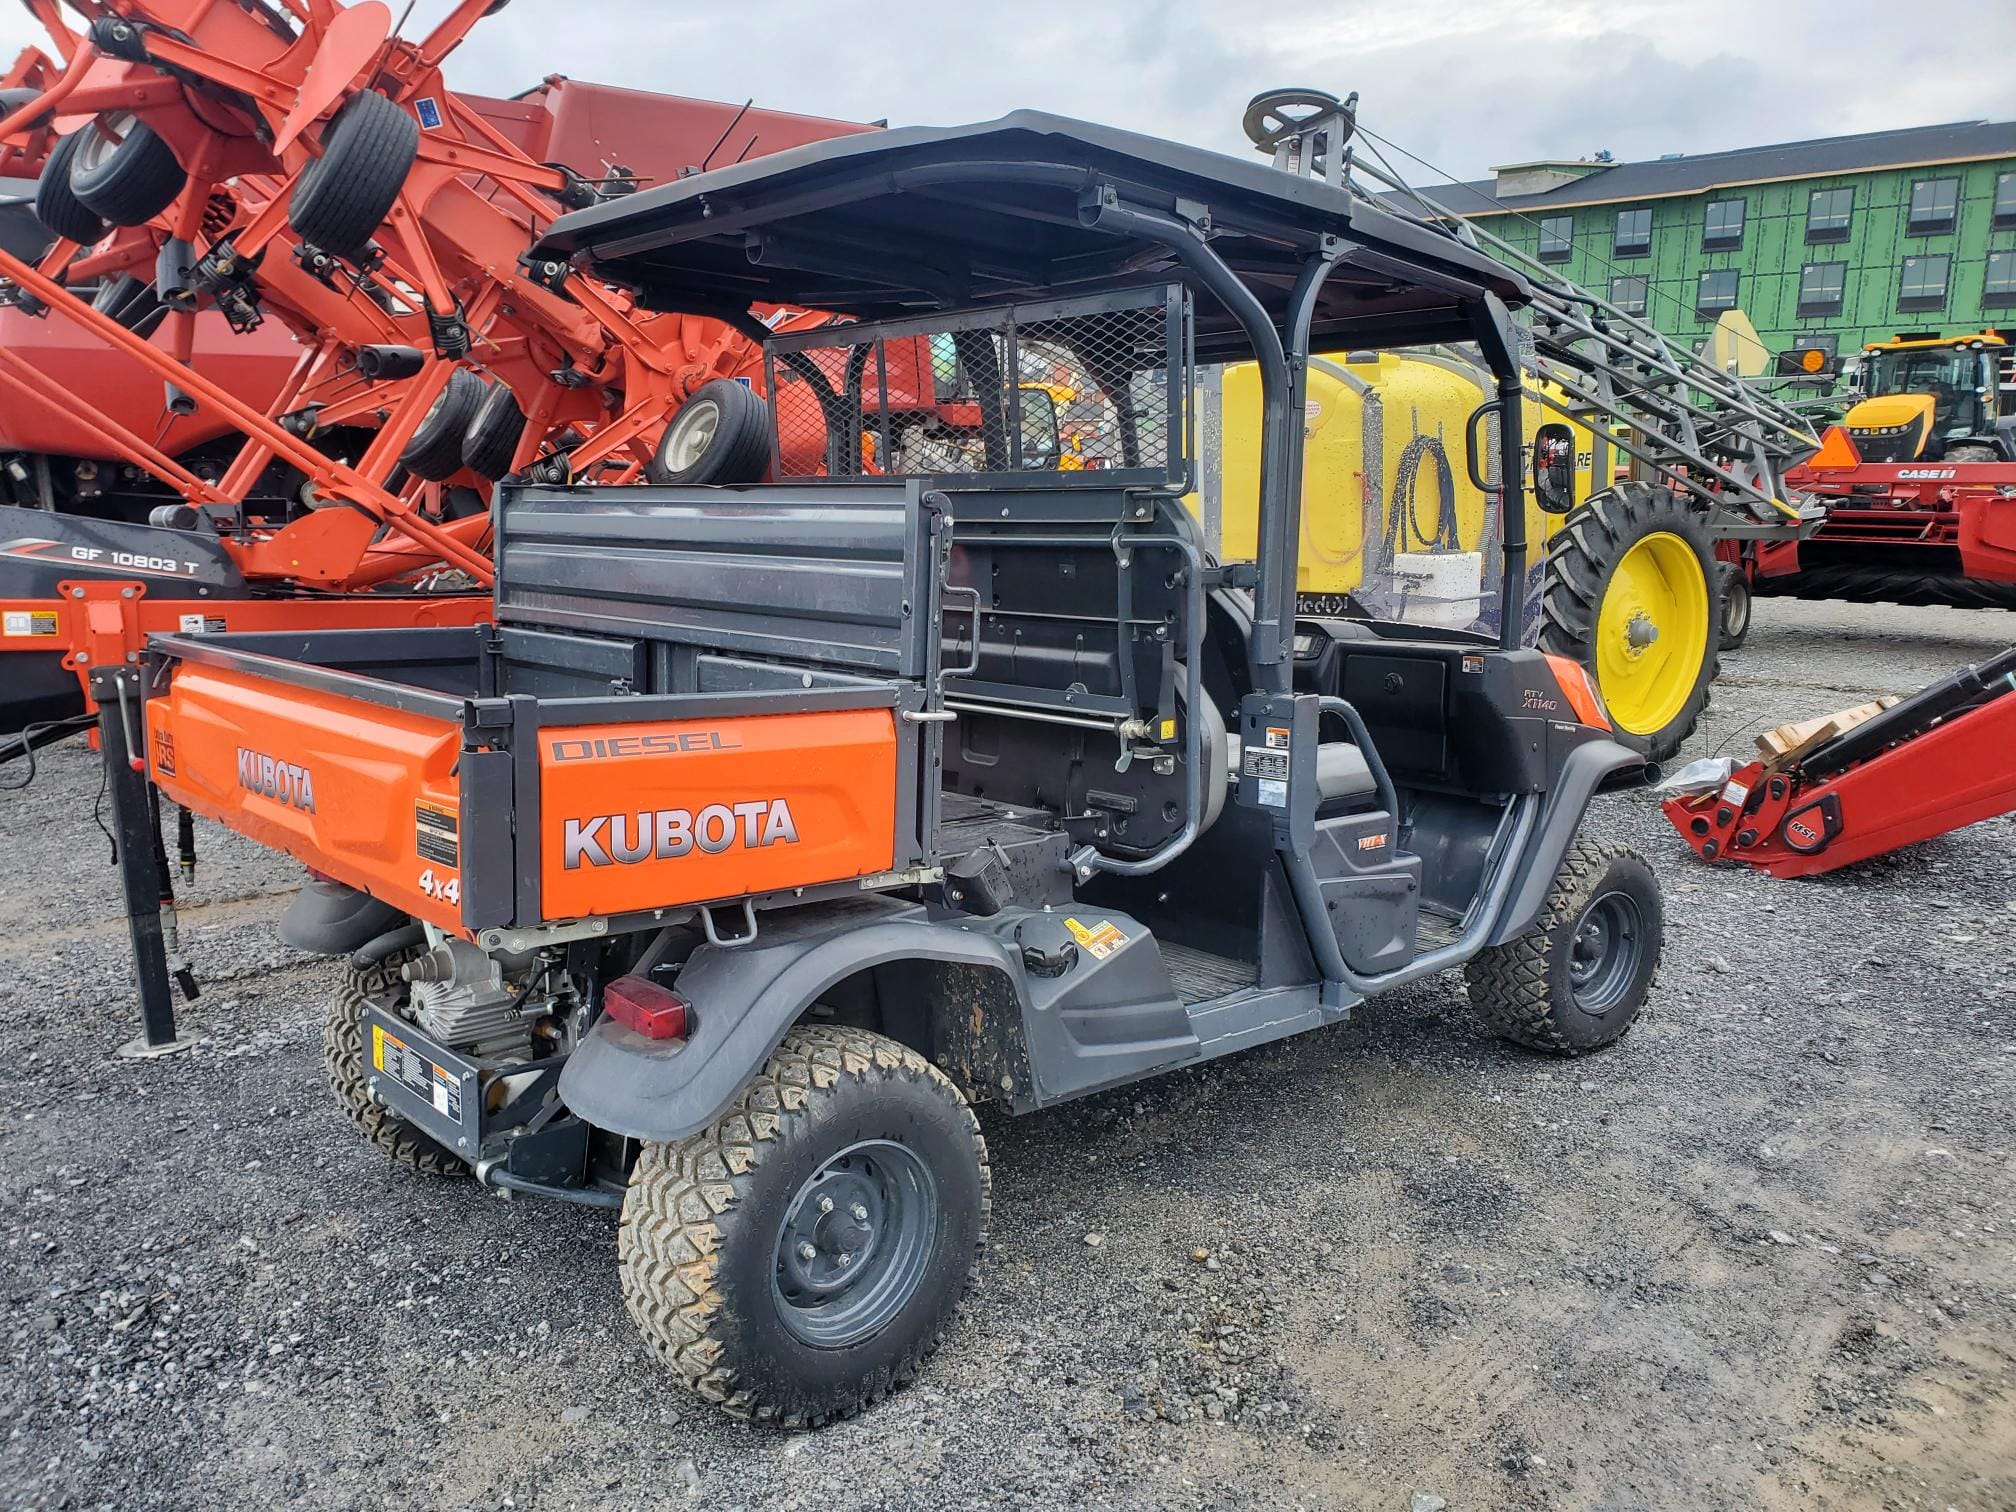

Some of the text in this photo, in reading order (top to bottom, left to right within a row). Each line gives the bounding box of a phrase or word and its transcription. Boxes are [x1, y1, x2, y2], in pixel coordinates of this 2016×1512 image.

[1897, 469, 1939, 479] CASE
[71, 546, 199, 574] GF 10803 T
[1521, 698, 1557, 711] X1140
[1523, 689, 1544, 698] RTV
[551, 731, 743, 761] DIESEL
[236, 746, 317, 815] KUBOTA
[563, 798, 799, 870] KUBOTA
[1791, 821, 1817, 841] MSL
